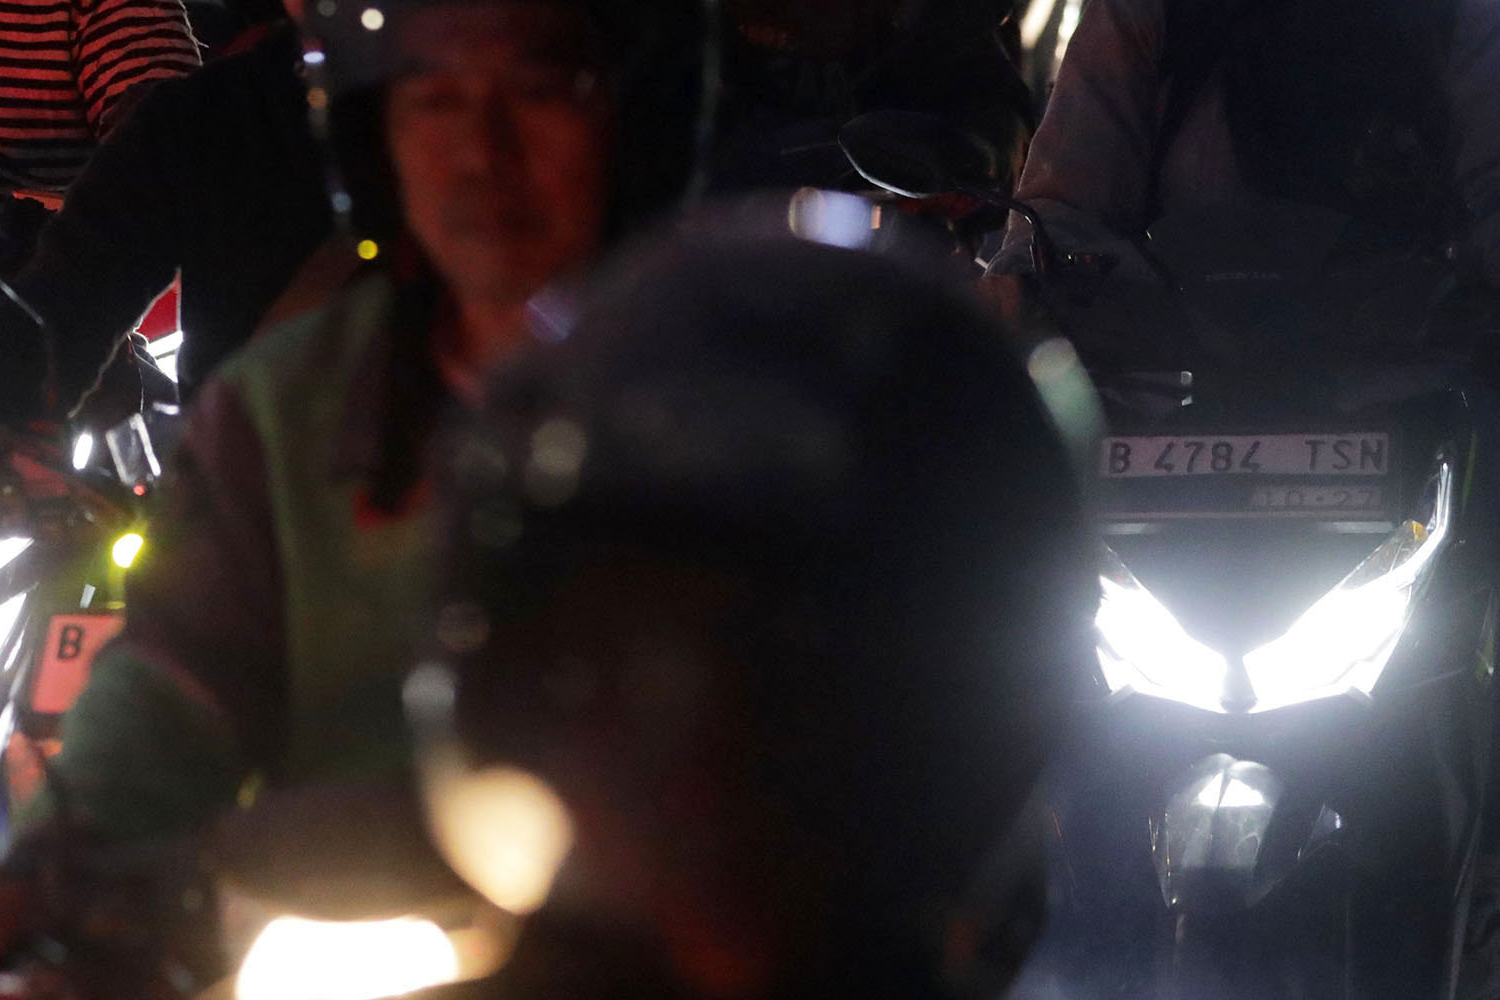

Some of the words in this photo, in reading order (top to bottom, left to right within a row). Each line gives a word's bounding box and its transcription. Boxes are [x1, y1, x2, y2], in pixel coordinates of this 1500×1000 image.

[1108, 441, 1132, 474] B
[1153, 440, 1262, 473] 4784
[1304, 438, 1384, 471] TSN
[57, 624, 85, 660] B
